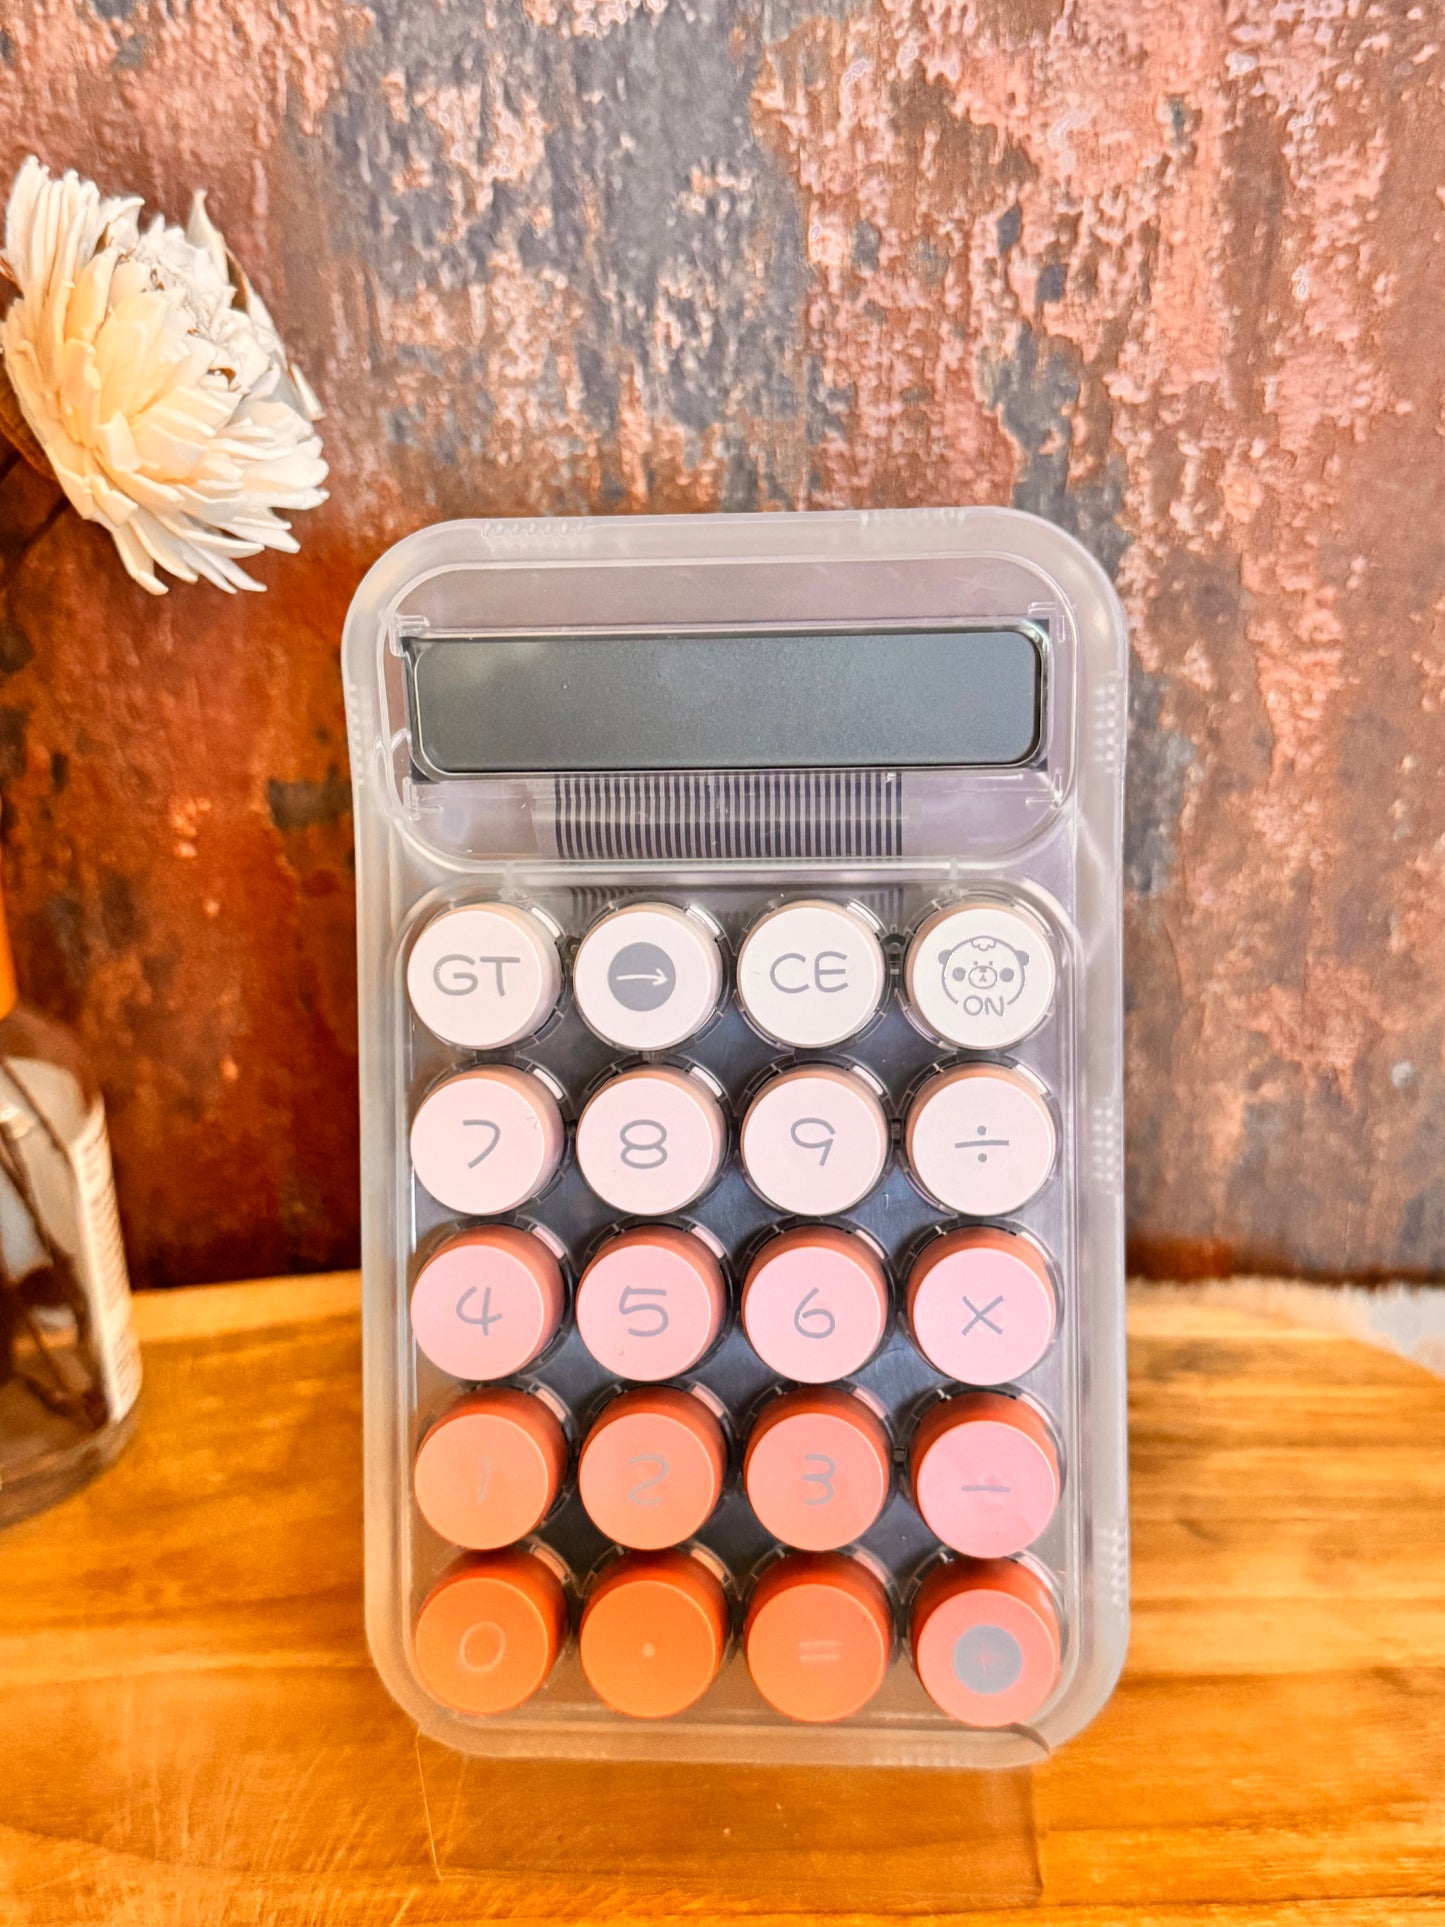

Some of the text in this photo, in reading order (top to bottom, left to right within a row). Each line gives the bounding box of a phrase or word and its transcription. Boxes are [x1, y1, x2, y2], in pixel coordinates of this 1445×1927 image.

[432, 954, 521, 997] GT
[769, 950, 849, 994] CE
[962, 994, 1005, 1016] ON
[462, 1119, 501, 1169] 7
[619, 1119, 668, 1169] 8
[790, 1117, 836, 1166] 9
[455, 1286, 502, 1336] 4
[618, 1286, 670, 1337] 5
[793, 1287, 836, 1339] 6
[476, 1454, 491, 1505] 1
[626, 1454, 670, 1505] 2
[802, 1453, 837, 1506] 3
